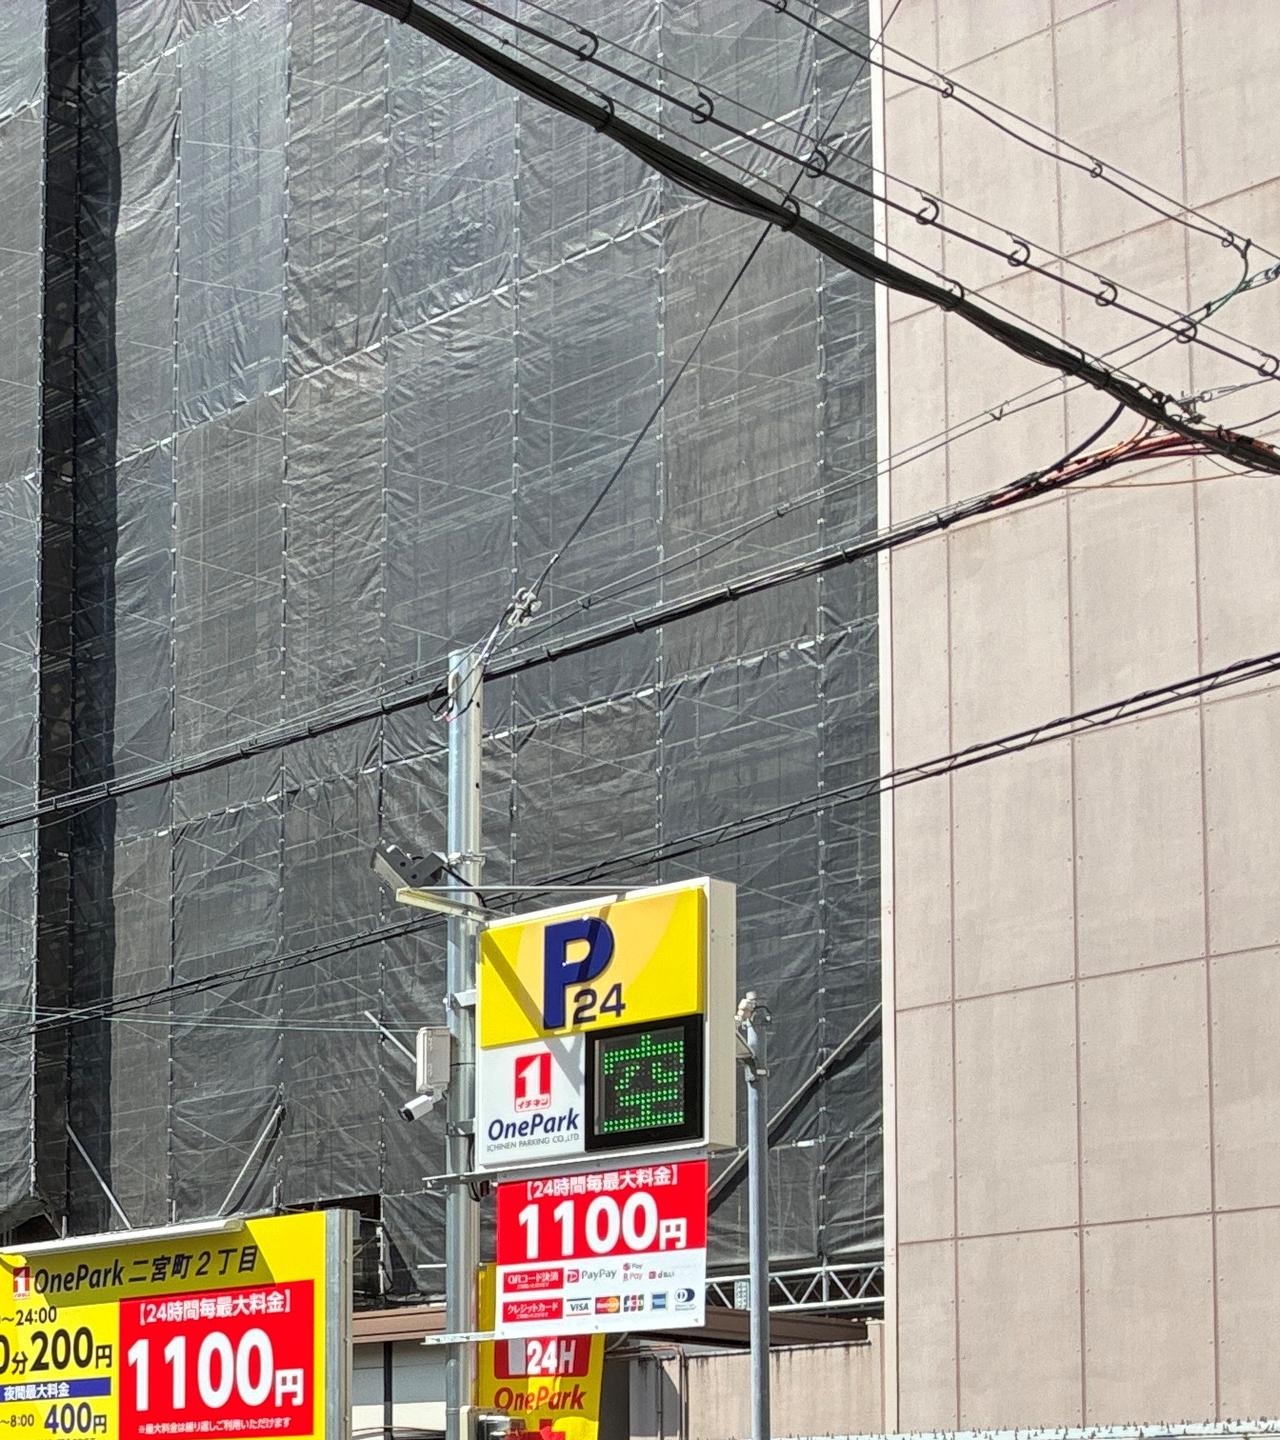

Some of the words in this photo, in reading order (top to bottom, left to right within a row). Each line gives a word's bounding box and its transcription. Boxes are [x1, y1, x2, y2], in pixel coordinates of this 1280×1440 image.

[543, 916, 615, 1030] P
[573, 988, 626, 1024] 24
[603, 1034, 685, 1133] 空
[488, 1107, 580, 1141] OnePark
[487, 1142, 517, 1152] ICHINEN
[519, 1137, 550, 1147] PARKING
[518, 1192, 687, 1259] 1100円
[34, 1259, 125, 1295] OnePark
[582, 1269, 617, 1281] PayPay
[570, 1303, 589, 1312] VISA
[127, 1327, 305, 1412] 1100円
[4, 1382, 70, 1401] 夜間最大料金
[494, 1384, 587, 1411] OnePark
[44, 1401, 107, 1434] 400円
